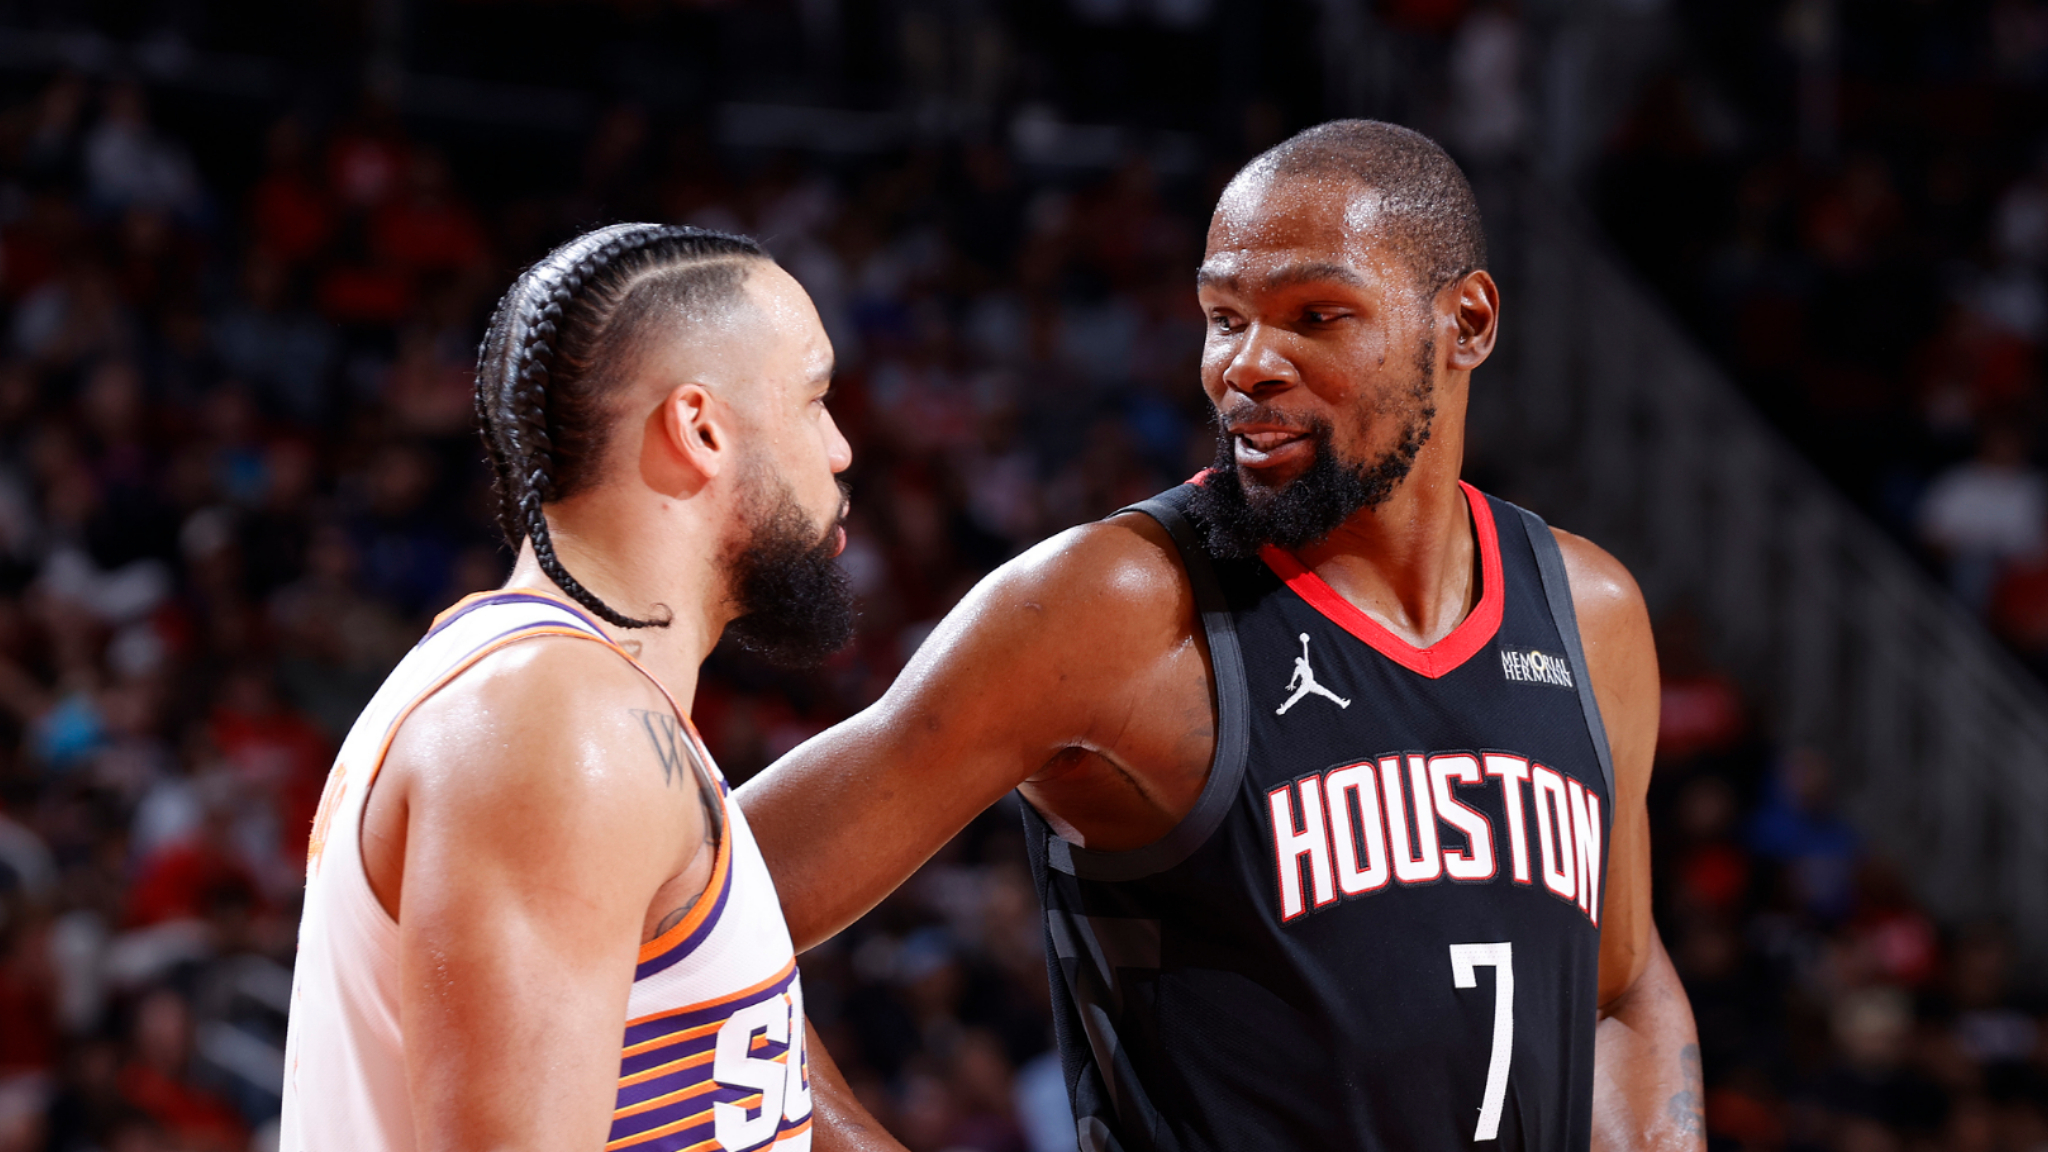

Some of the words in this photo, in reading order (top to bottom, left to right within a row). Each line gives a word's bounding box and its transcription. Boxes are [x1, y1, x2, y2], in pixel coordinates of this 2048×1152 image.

[1501, 650, 1570, 674] MEMORIAL
[1503, 664, 1573, 688] HERMANN
[1267, 752, 1600, 929] HOUSTON
[1449, 942, 1515, 1142] 7
